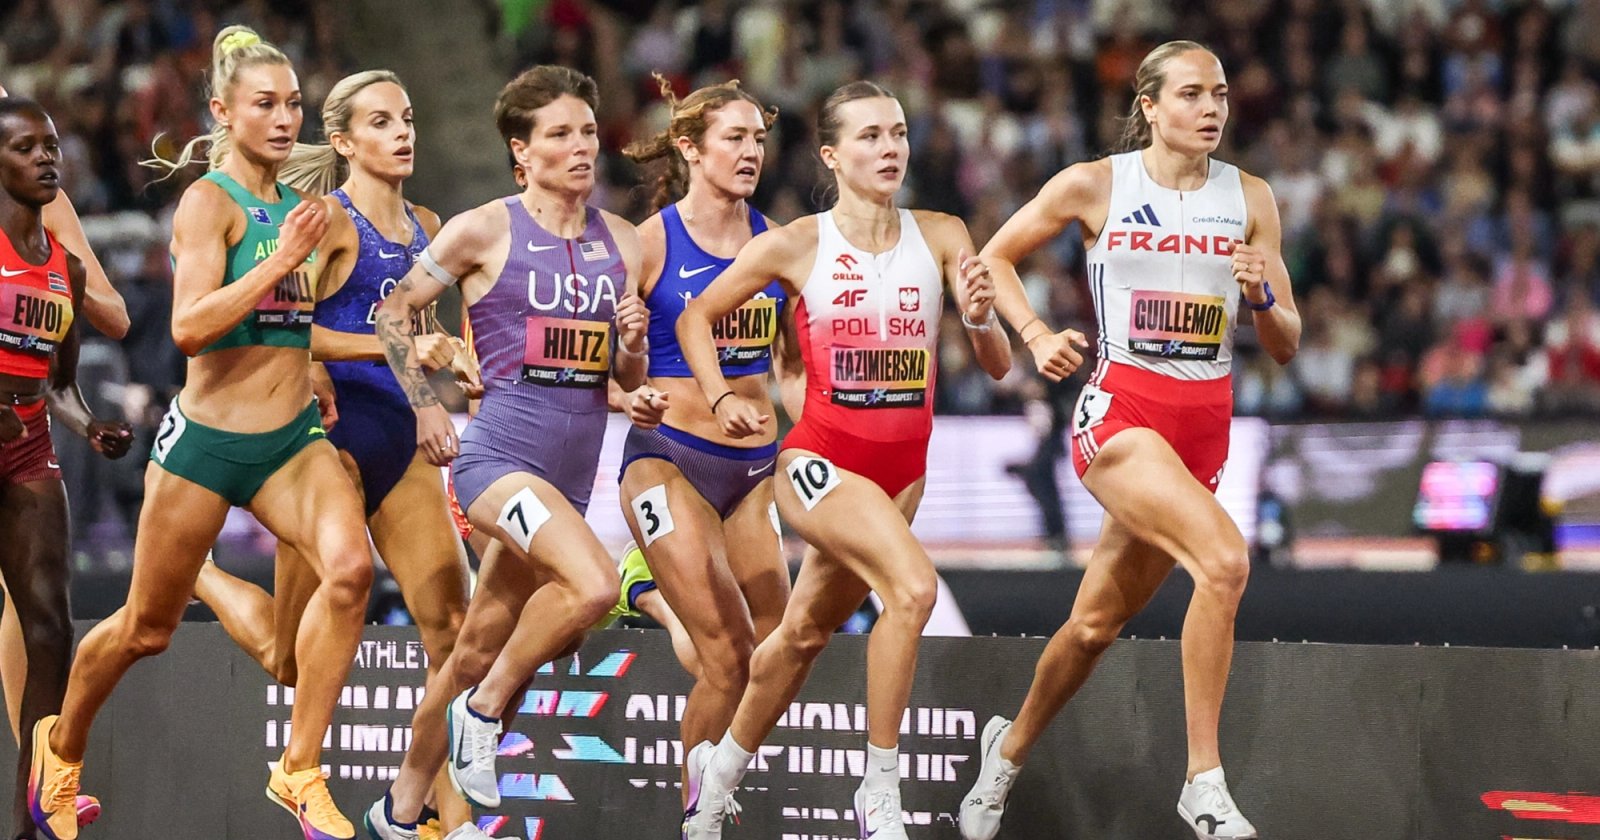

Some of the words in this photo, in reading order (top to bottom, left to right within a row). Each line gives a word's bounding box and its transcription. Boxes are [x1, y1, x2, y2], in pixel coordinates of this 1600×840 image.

[1107, 231, 1244, 256] FRANC
[527, 270, 618, 314] USA
[832, 289, 868, 307] 4F
[12, 293, 63, 334] EWOI
[711, 307, 772, 340] ACKAY
[1134, 298, 1224, 336] GUILLEMOT
[543, 326, 606, 363] HILTZ
[1133, 342, 1164, 353] ULTIMATE
[1181, 345, 1208, 355] BUDAPEST
[528, 368, 558, 380] ULTIMATE
[834, 349, 926, 382] KAZIMIERSKA
[885, 392, 914, 403] BUDAPEST
[1078, 394, 1096, 429] 5
[791, 459, 830, 501] 10
[506, 501, 530, 538] 7
[640, 500, 660, 537] 3
